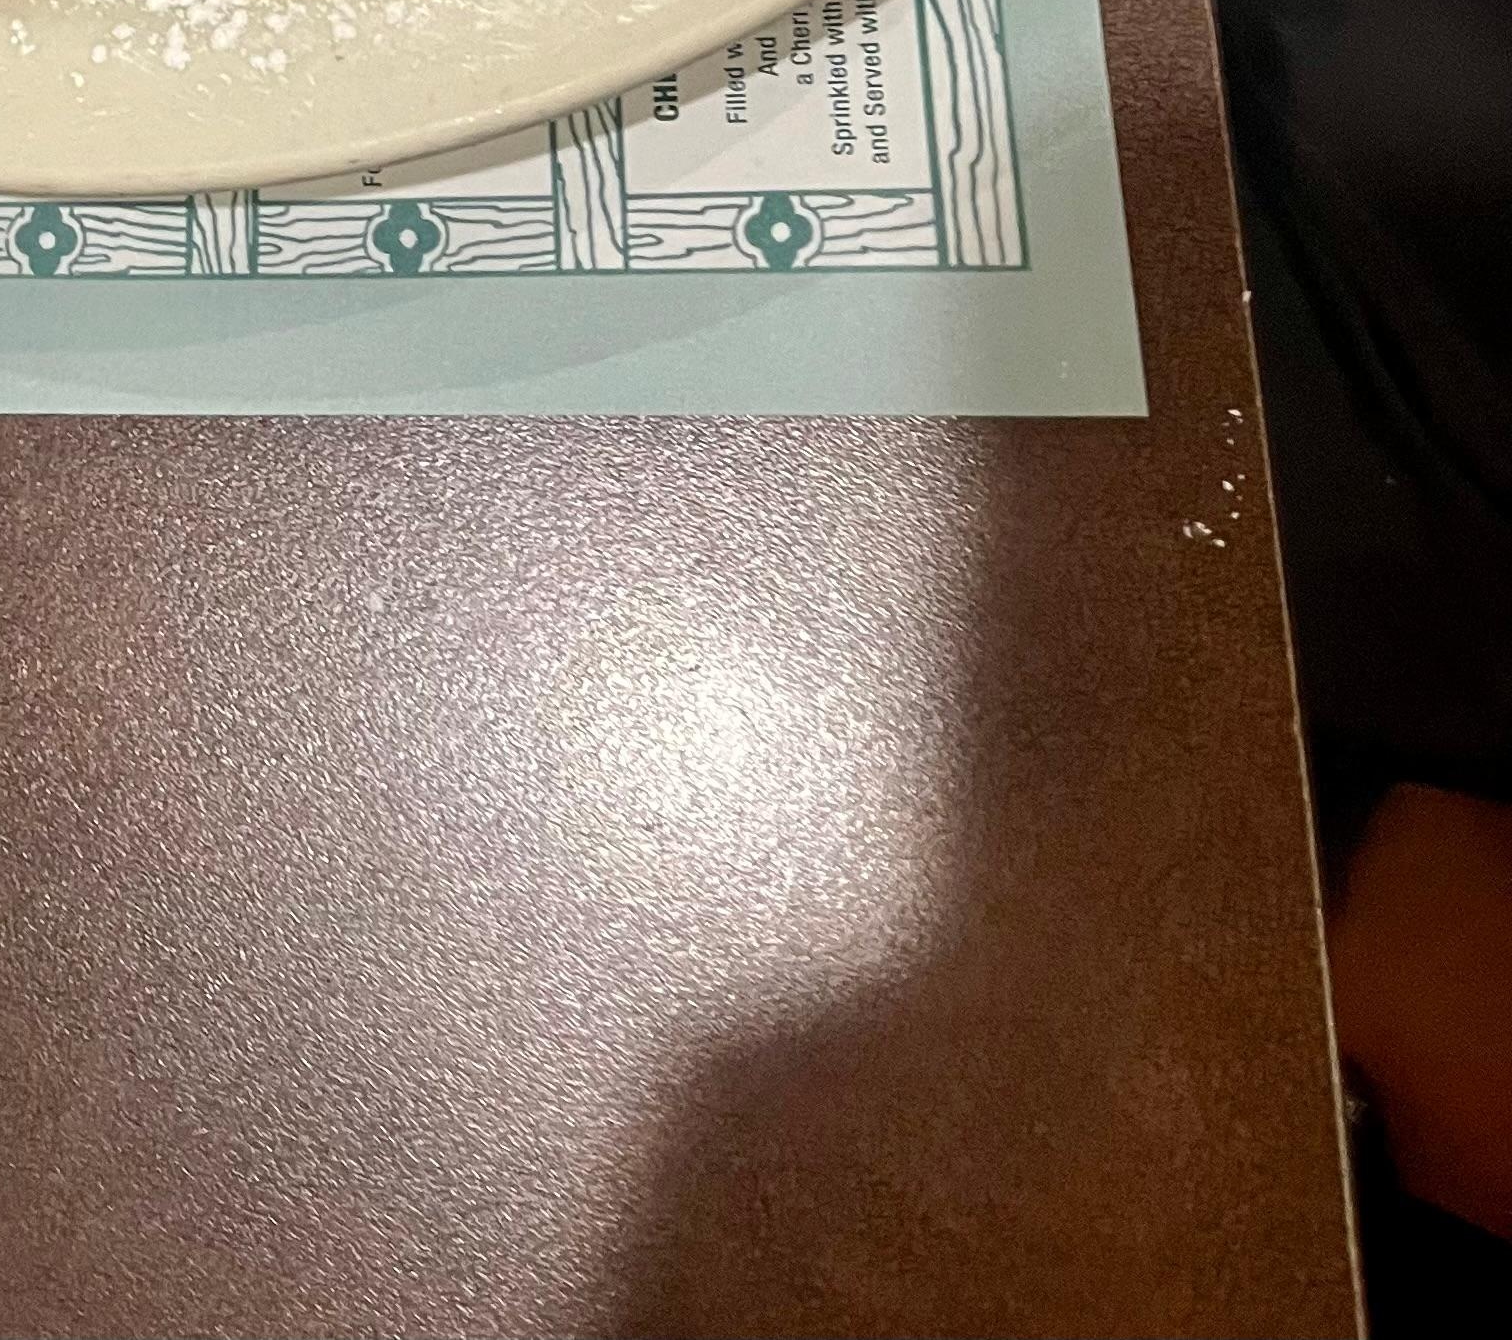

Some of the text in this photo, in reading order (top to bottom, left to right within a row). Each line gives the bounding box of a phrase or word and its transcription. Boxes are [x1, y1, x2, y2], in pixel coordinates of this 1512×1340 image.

[755, 36, 779, 77] And
[796, 73, 814, 85] a
[823, 1, 857, 156] Sprinkled with
[860, 42, 886, 117] Served
[723, 66, 747, 124] Filled
[866, 124, 890, 164] and
